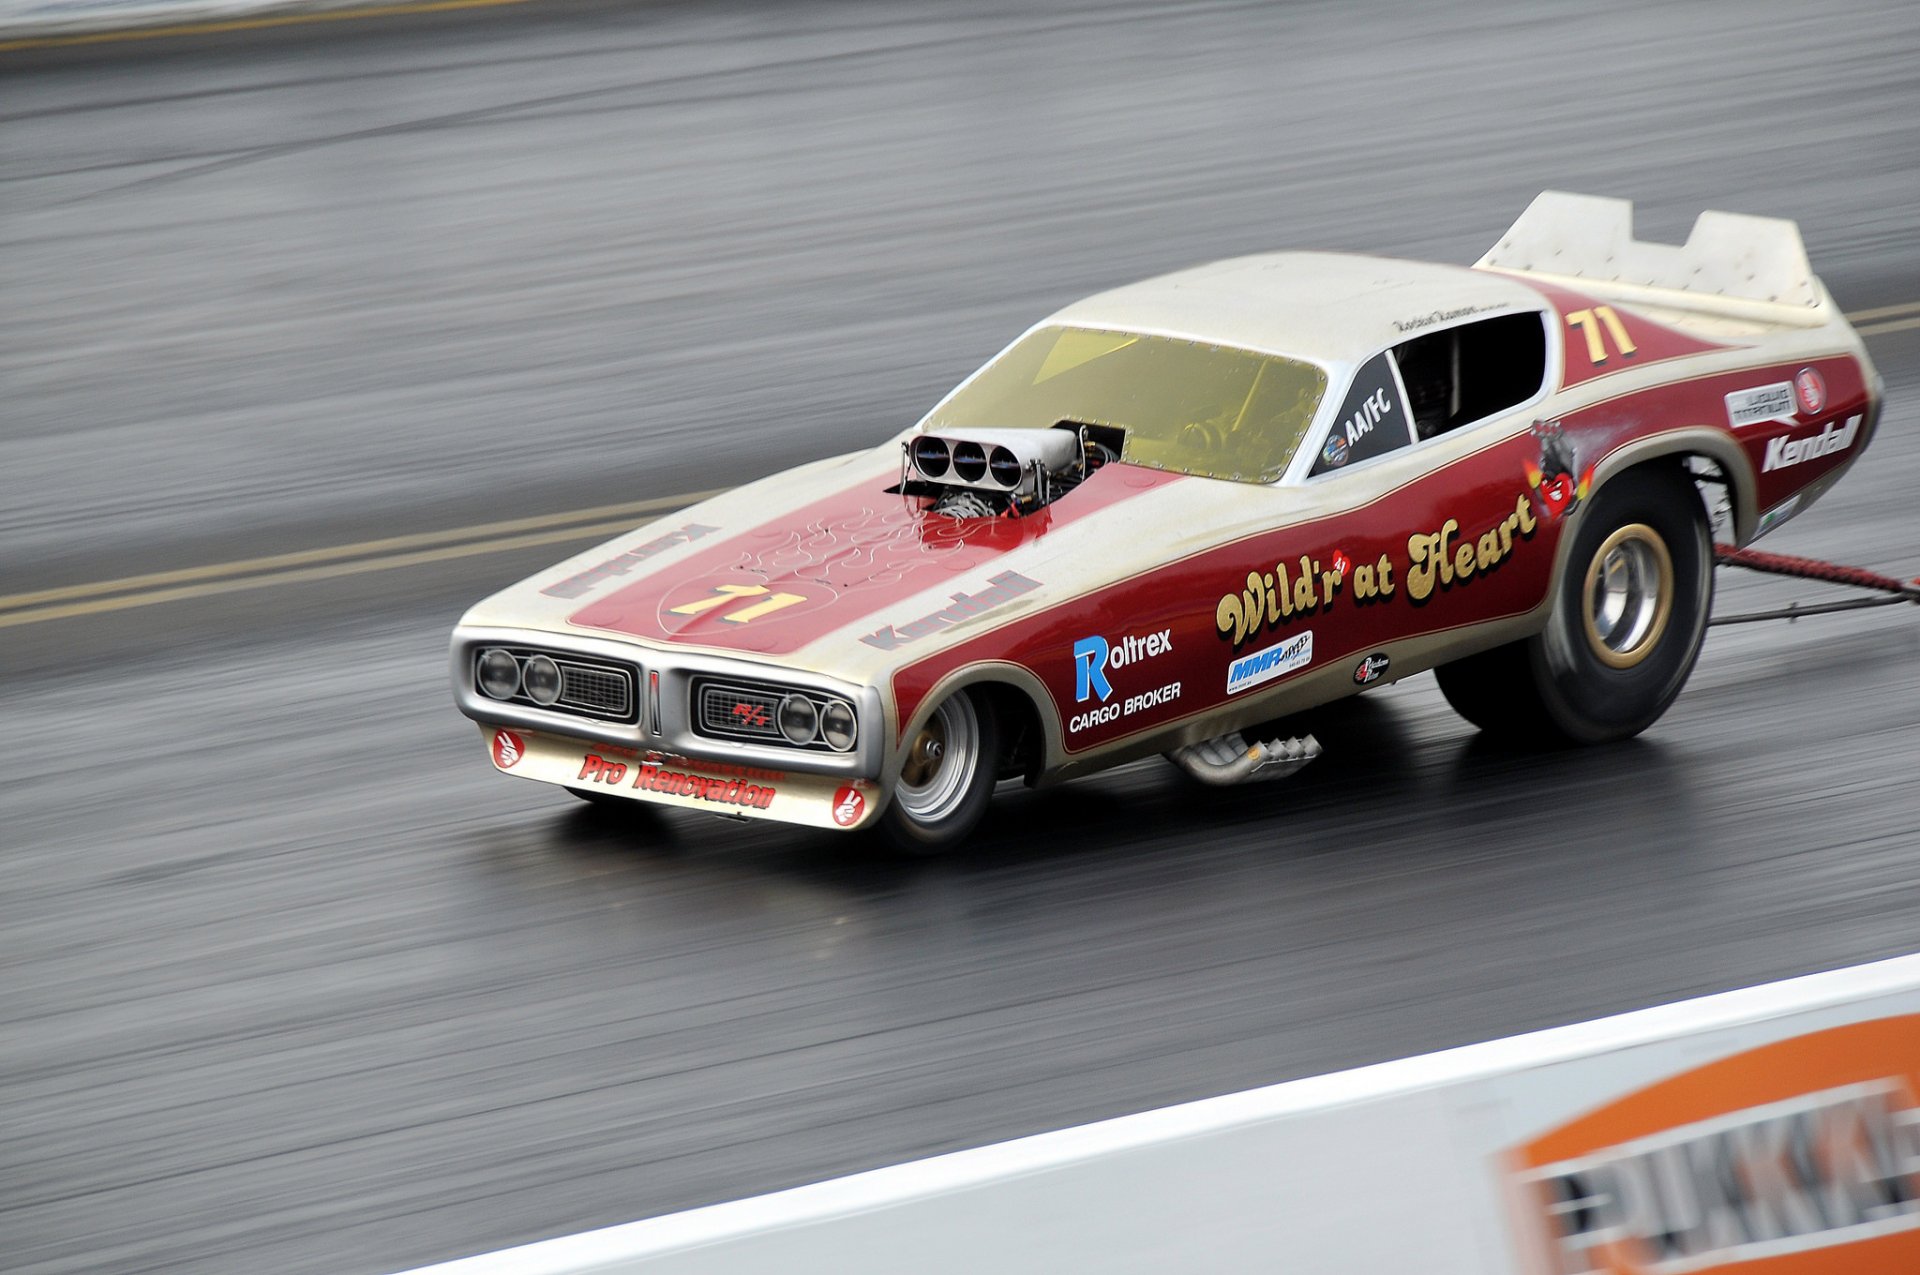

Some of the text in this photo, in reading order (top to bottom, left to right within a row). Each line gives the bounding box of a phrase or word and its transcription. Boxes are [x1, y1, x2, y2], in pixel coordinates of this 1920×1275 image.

[1565, 305, 1638, 366] 71
[1345, 387, 1392, 448] AA/FC
[1762, 414, 1863, 473] Kendall
[1216, 493, 1537, 646] Wild'r at Heart
[858, 569, 1045, 651] Kendall
[1074, 628, 1173, 703] Roltrex
[1230, 647, 1283, 684] MMR
[732, 703, 773, 727] R/T
[1069, 681, 1181, 733] CARGO BROKER
[577, 753, 628, 784] Pro
[632, 764, 777, 810] Renovation
